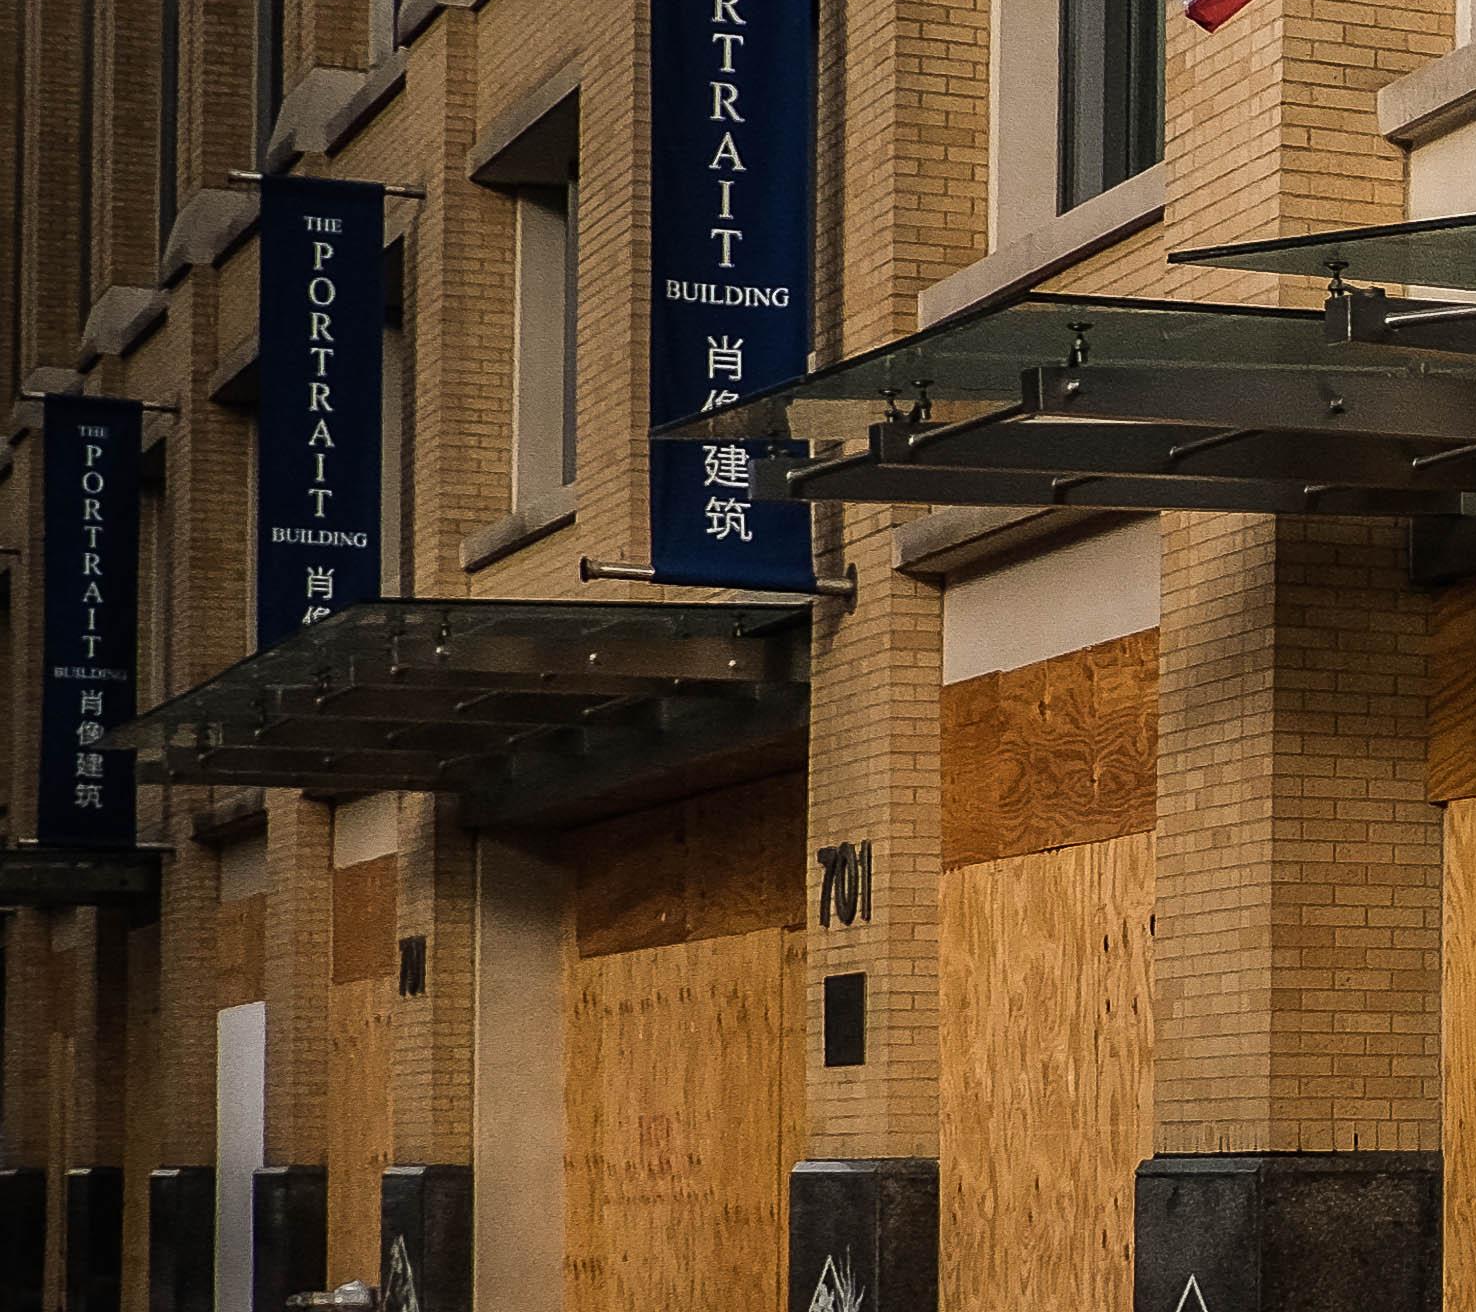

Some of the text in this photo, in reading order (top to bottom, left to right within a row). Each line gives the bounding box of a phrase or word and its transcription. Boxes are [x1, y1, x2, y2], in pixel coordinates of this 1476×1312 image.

[303, 215, 343, 233] THE
[666, 279, 790, 308] BUILDING
[308, 241, 337, 518] PORTRAIT
[82, 444, 105, 659] PORTRAIT
[272, 527, 368, 548] BUILDING
[817, 838, 872, 929] 701
